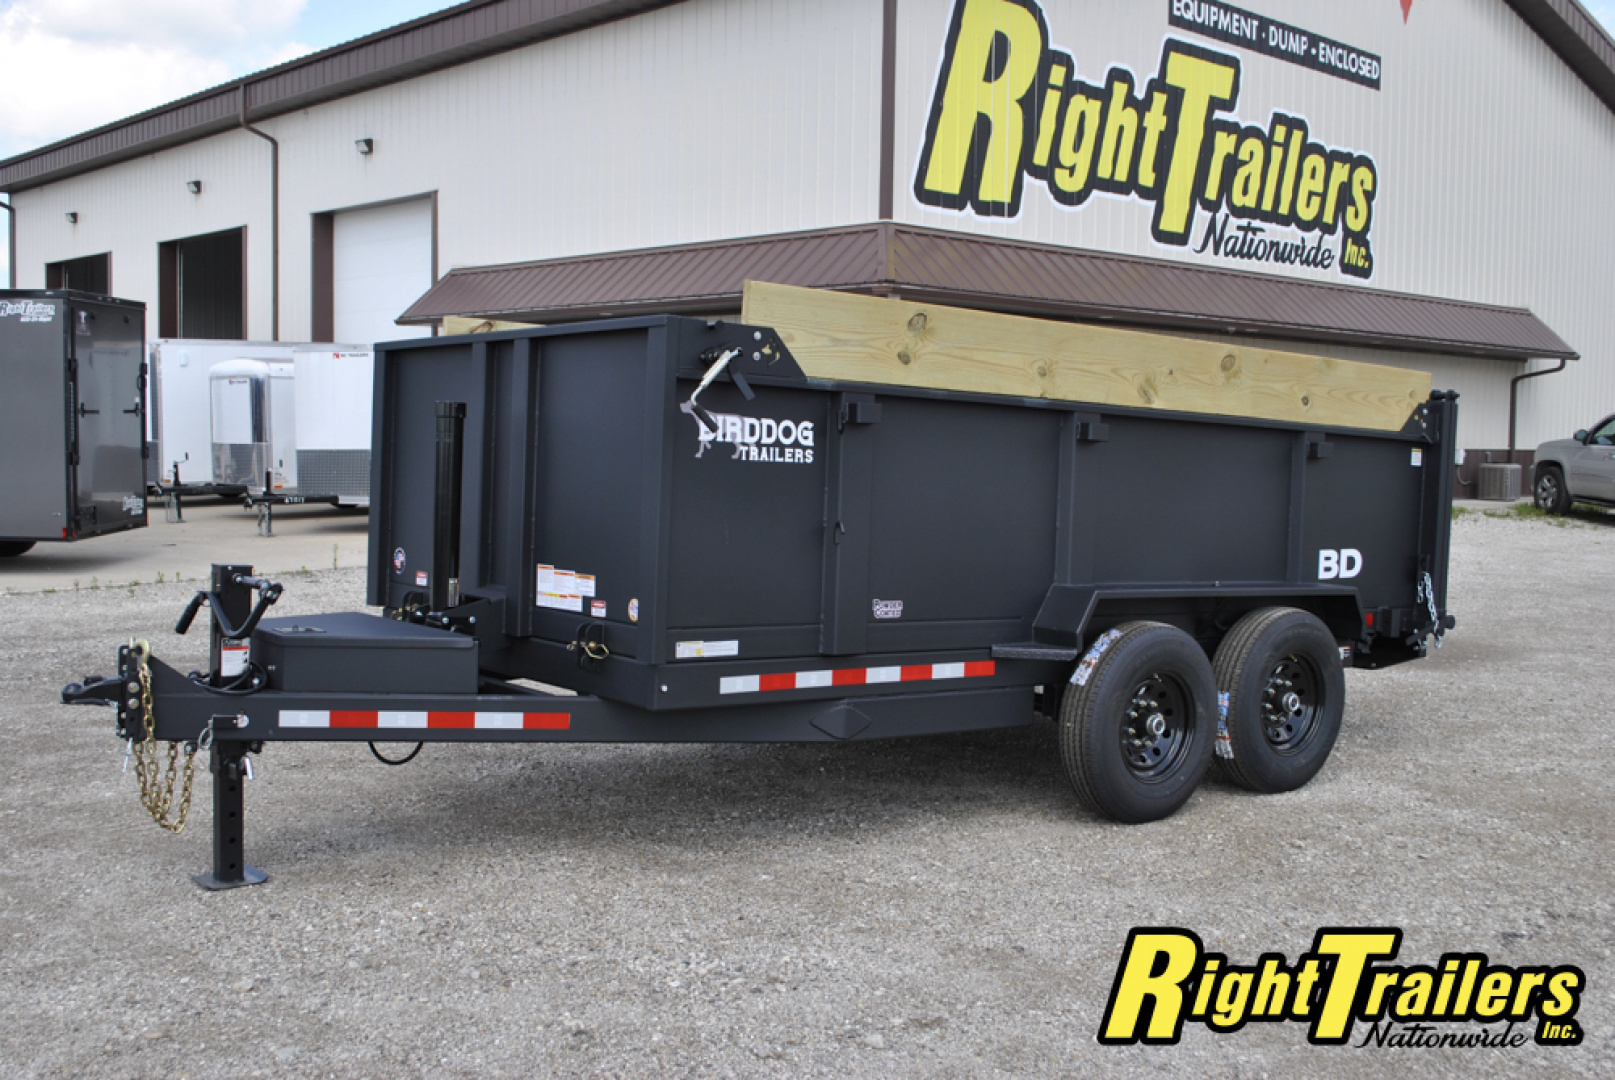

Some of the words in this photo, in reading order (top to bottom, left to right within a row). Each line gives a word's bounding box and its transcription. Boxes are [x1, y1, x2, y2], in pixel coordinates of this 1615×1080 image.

[1172, 0, 1258, 40] EQUIPMENT
[1269, 25, 1308, 55] DUMP
[1318, 42, 1380, 80] ENCLOSED
[1193, 212, 1335, 269] Nationwide
[1344, 236, 1371, 269] Inc.
[740, 446, 814, 463] TRAILERS
[1317, 548, 1363, 580] BD
